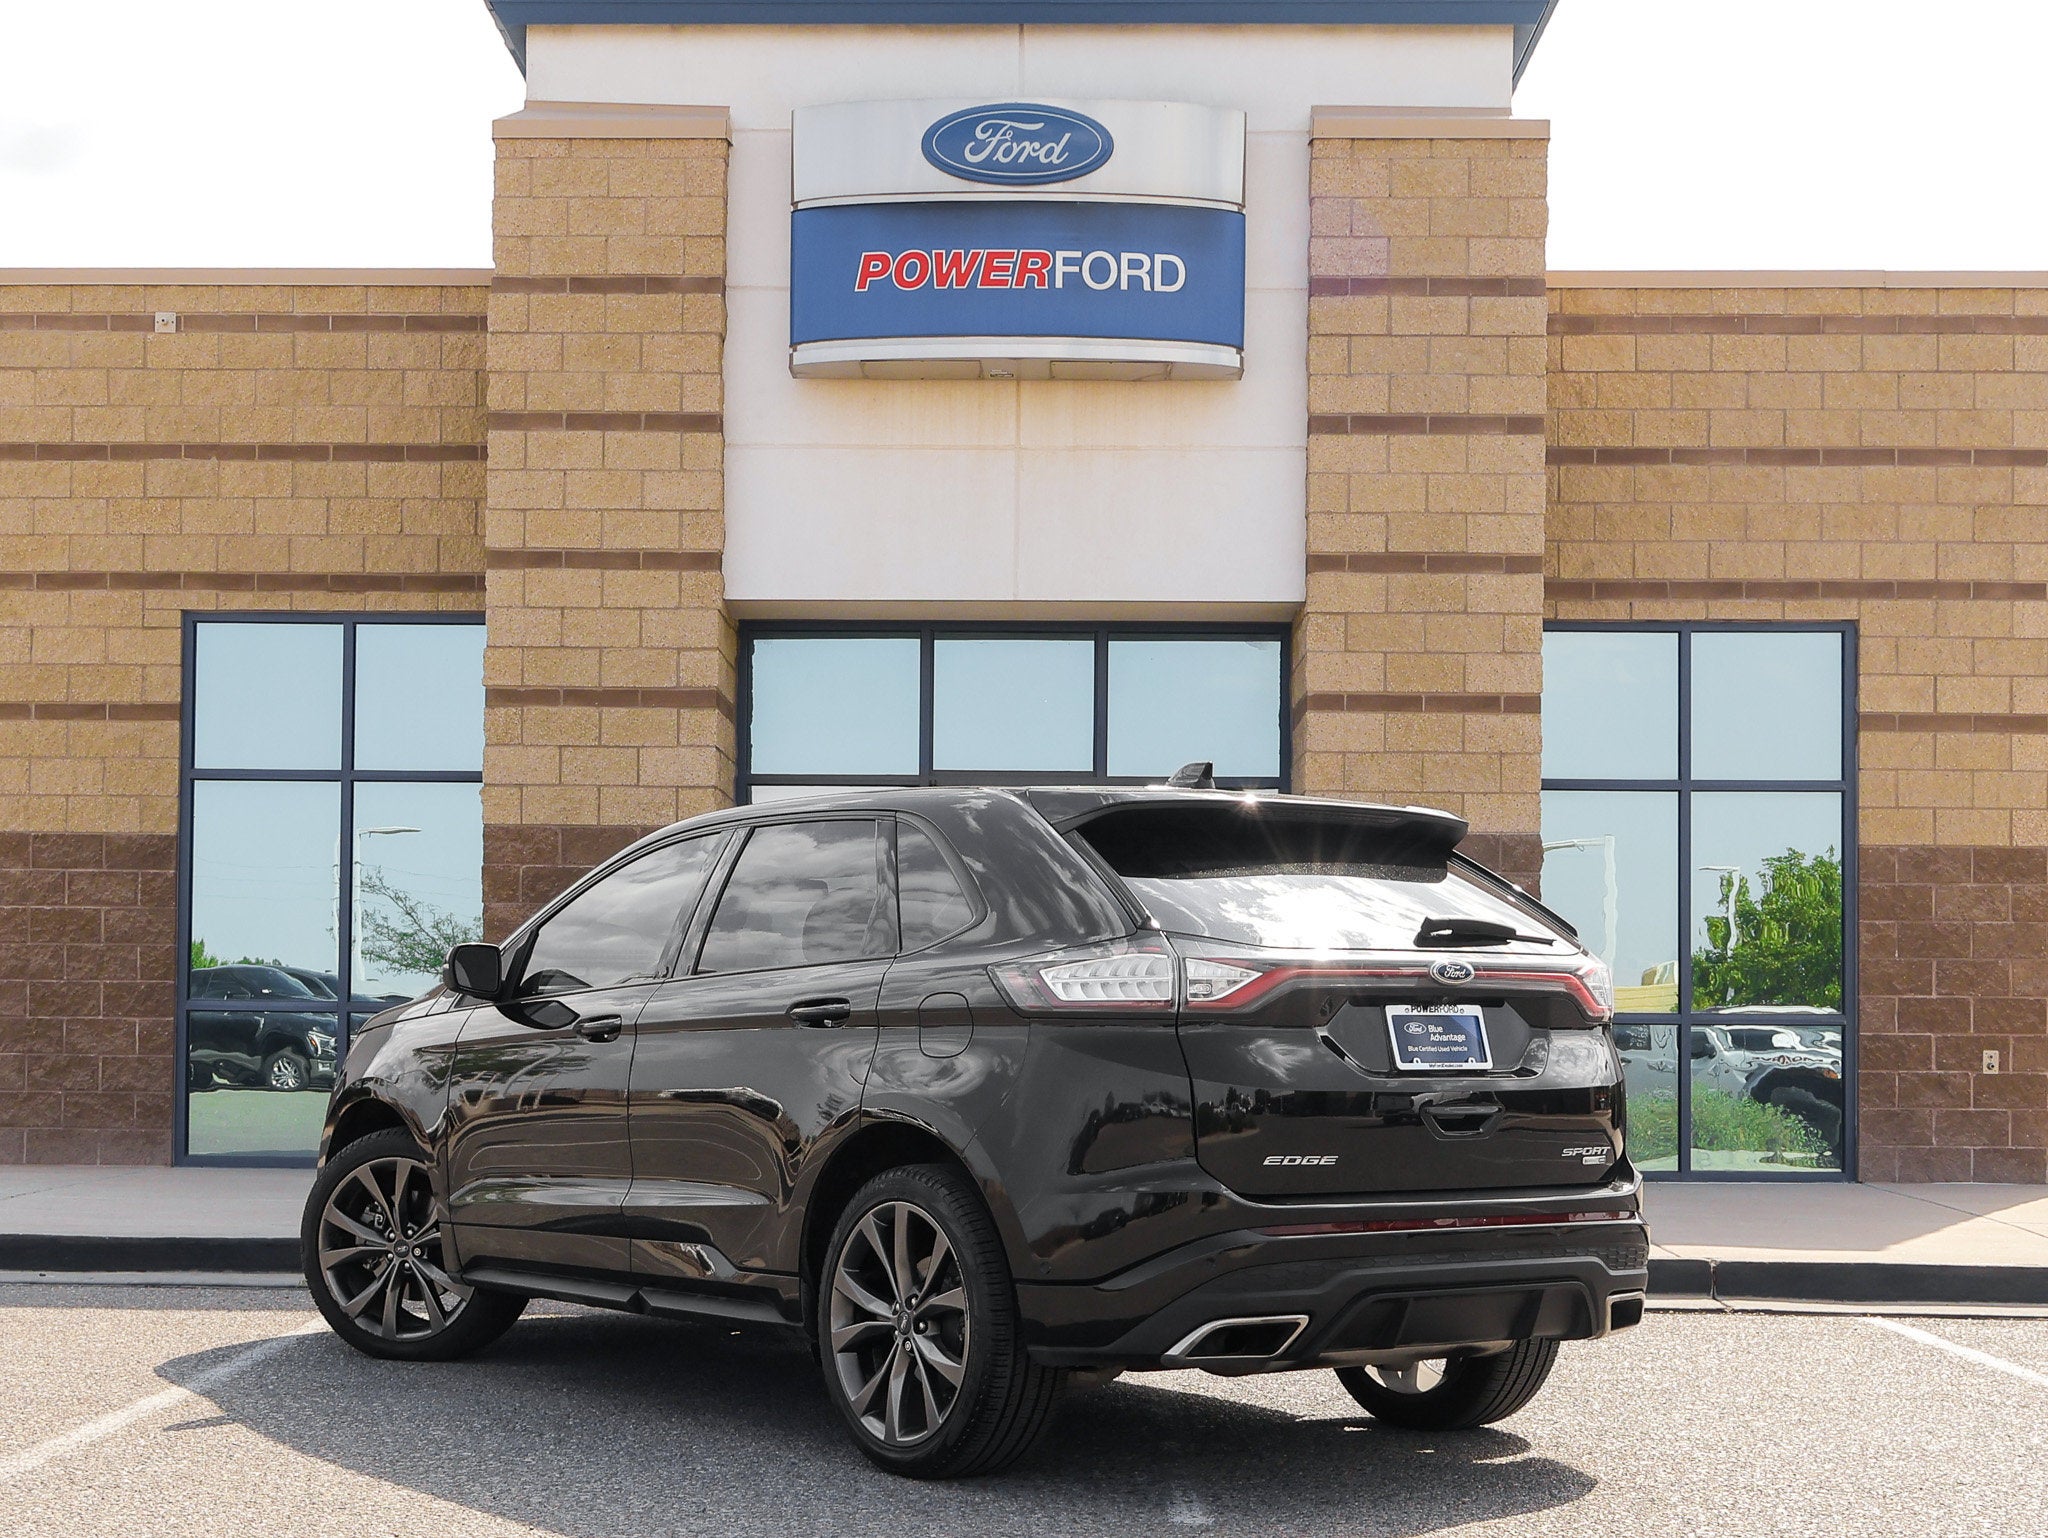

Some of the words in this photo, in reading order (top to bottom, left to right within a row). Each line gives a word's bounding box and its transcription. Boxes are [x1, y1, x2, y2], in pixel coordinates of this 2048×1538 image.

[963, 119, 1072, 164] Ford
[1444, 964, 1466, 978] Ford
[1427, 1024, 1444, 1033] Blue
[1430, 1033, 1467, 1042] Advantage
[1561, 1146, 1611, 1157] SPORT
[1262, 1155, 1339, 1166] EDGE
